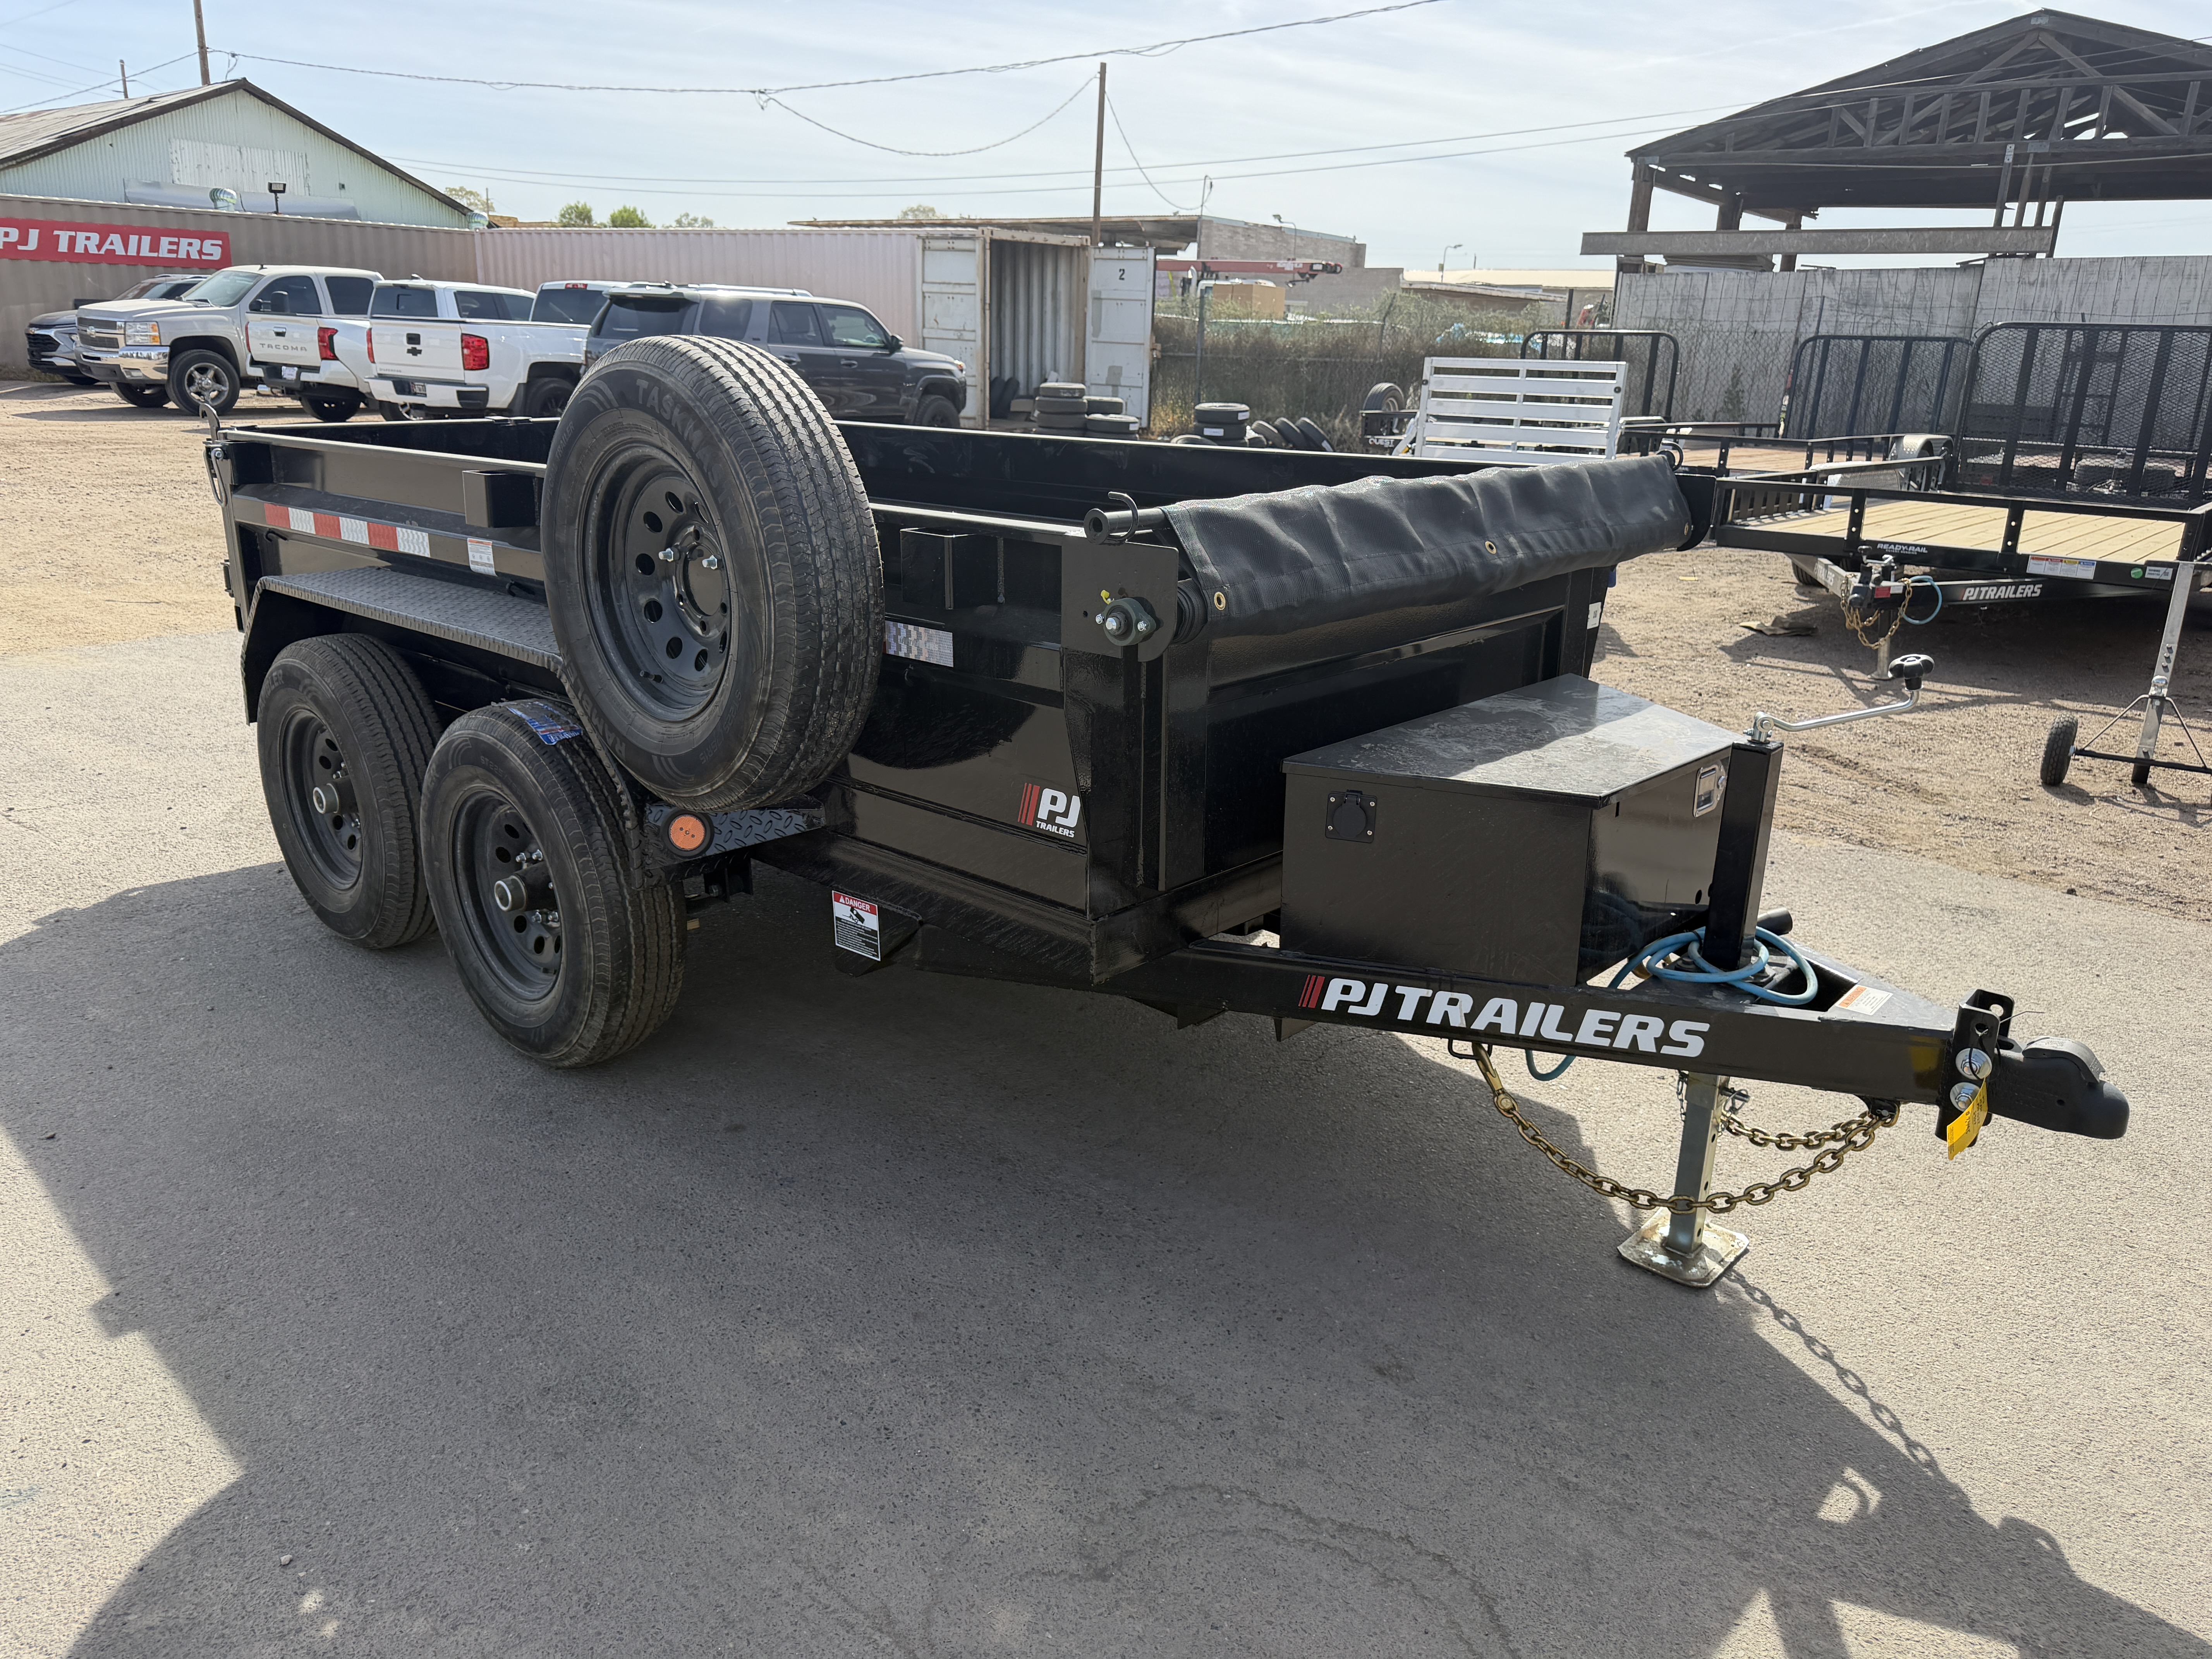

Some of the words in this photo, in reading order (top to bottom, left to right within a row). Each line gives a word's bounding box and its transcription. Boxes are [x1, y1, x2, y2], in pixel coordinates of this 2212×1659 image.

[0, 227, 40, 251] PJ
[53, 230, 223, 261] TRAILERS
[1118, 269, 1125, 280] 2
[259, 343, 307, 352] TACOMA
[555, 421, 575, 461] TRAILER
[1963, 587, 1979, 601] PJ
[1979, 584, 2042, 599] TRAILERS
[1038, 788, 1080, 828] PJ
[1036, 821, 1075, 838] TRAILERS
[845, 897, 871, 912] DANGER
[1321, 978, 1388, 1016] PJ
[1395, 986, 1711, 1057] TRAILERS
